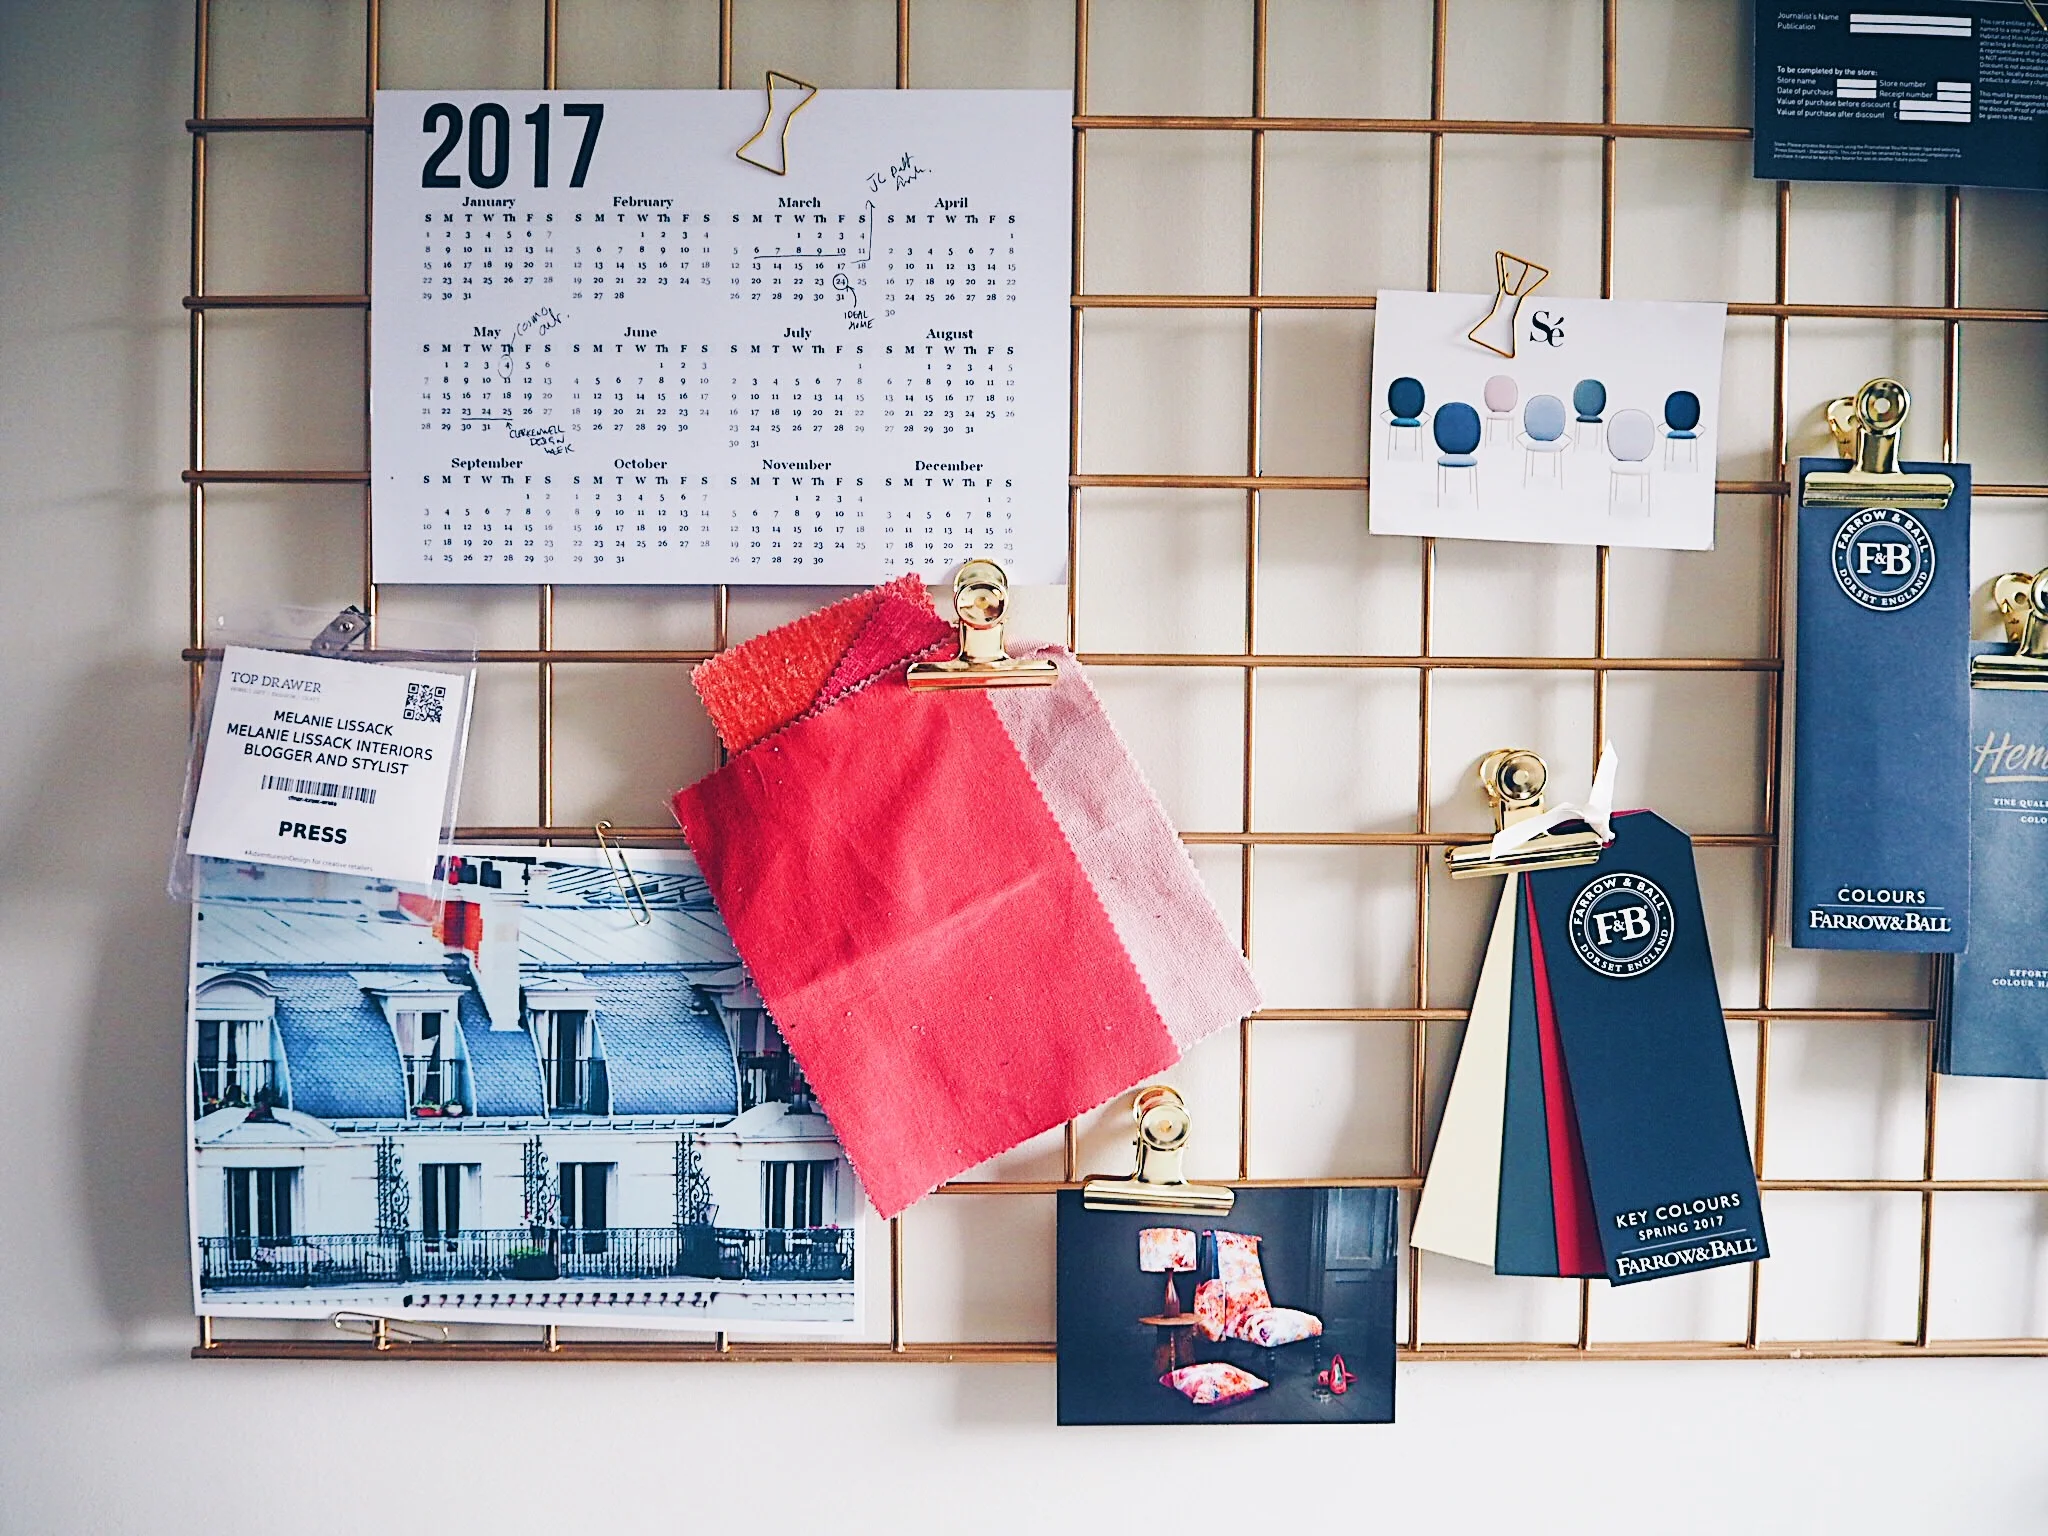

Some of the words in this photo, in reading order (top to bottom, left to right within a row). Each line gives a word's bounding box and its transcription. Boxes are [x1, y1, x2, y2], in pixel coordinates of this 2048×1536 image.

[1777, 21, 1816, 30] Publication
[1787, 66, 1795, 74] be
[1797, 67, 1833, 75] completed
[1834, 68, 1843, 76] by
[1802, 88, 1834, 96] purchase
[1880, 90, 1905, 98] Receipt
[1805, 99, 1836, 107] purchase
[1805, 109, 1836, 117] purchase
[421, 103, 604, 189] 2017
[462, 196, 516, 210] January
[612, 196, 674, 210] February
[778, 196, 820, 208] March
[934, 196, 968, 210] April
[424, 214, 432, 222] S
[444, 214, 454, 222] M
[464, 214, 474, 222] T
[482, 214, 494, 222] W
[502, 212, 516, 222] Th
[526, 212, 534, 222] F
[546, 214, 554, 222] S
[594, 262, 604, 270] 13
[616, 262, 624, 270] 14
[638, 262, 646, 270] 15
[658, 260, 668, 268] 16
[680, 262, 690, 270] 17
[474, 326, 502, 340] May
[624, 326, 658, 338] June
[784, 326, 812, 340] July
[926, 328, 974, 342] August
[1530, 310, 1566, 348] Sé
[750, 408, 760, 416] 17
[772, 408, 780, 416] 18
[452, 456, 524, 472] September
[614, 458, 668, 470] October
[762, 458, 832, 470] November
[916, 460, 984, 472] December
[924, 526, 934, 534] 12
[944, 528, 952, 536] 13
[986, 528, 994, 536] 15
[1838, 510, 1887, 550] FARROW
[1891, 513, 1901, 522] &
[1904, 520, 1929, 553] BALL
[594, 540, 604, 548] 23
[616, 540, 626, 548] 24
[636, 540, 646, 548] 25
[658, 540, 668, 548] 26
[680, 540, 688, 548] 27
[1856, 542, 1912, 575] F&B
[1840, 568, 1878, 604] DORSET
[1881, 572, 1928, 606] ENGLAND
[231, 672, 258, 684] TOP
[262, 676, 321, 693] DRAWER
[274, 710, 333, 728] MELANIE
[337, 718, 393, 736] LISSACK
[227, 723, 288, 742] MELANIE
[293, 732, 352, 750] LISSACK
[356, 740, 434, 760] INTERIORS
[244, 744, 312, 763] BLOGGER
[316, 754, 348, 768] AND
[352, 758, 408, 775] STYLIST
[1994, 798, 2016, 806] FINE
[2020, 816, 2048, 824] COLO
[278, 820, 348, 844] PRESS
[322, 860, 346, 868] creative
[348, 863, 373, 871] retailers
[1574, 878, 1616, 925] FARROW
[1622, 878, 1632, 888] &
[1636, 881, 1662, 911] BALL
[1838, 888, 1926, 904] COLOURS
[1592, 906, 1650, 945] F&B
[1810, 910, 1952, 932] FARROW&BALL
[1580, 944, 1622, 972] DORSET
[1628, 929, 1669, 972] ENGLAND
[2009, 969, 2048, 978] EFFORT
[1992, 978, 2034, 987] COLOUR
[1616, 1210, 1648, 1228] KEY
[1656, 1194, 1740, 1220] COLOURS
[1638, 1222, 1688, 1241] SPRING
[1694, 1216, 1724, 1231] 2017
[1616, 1238, 1758, 1276] FARROW&BALL
